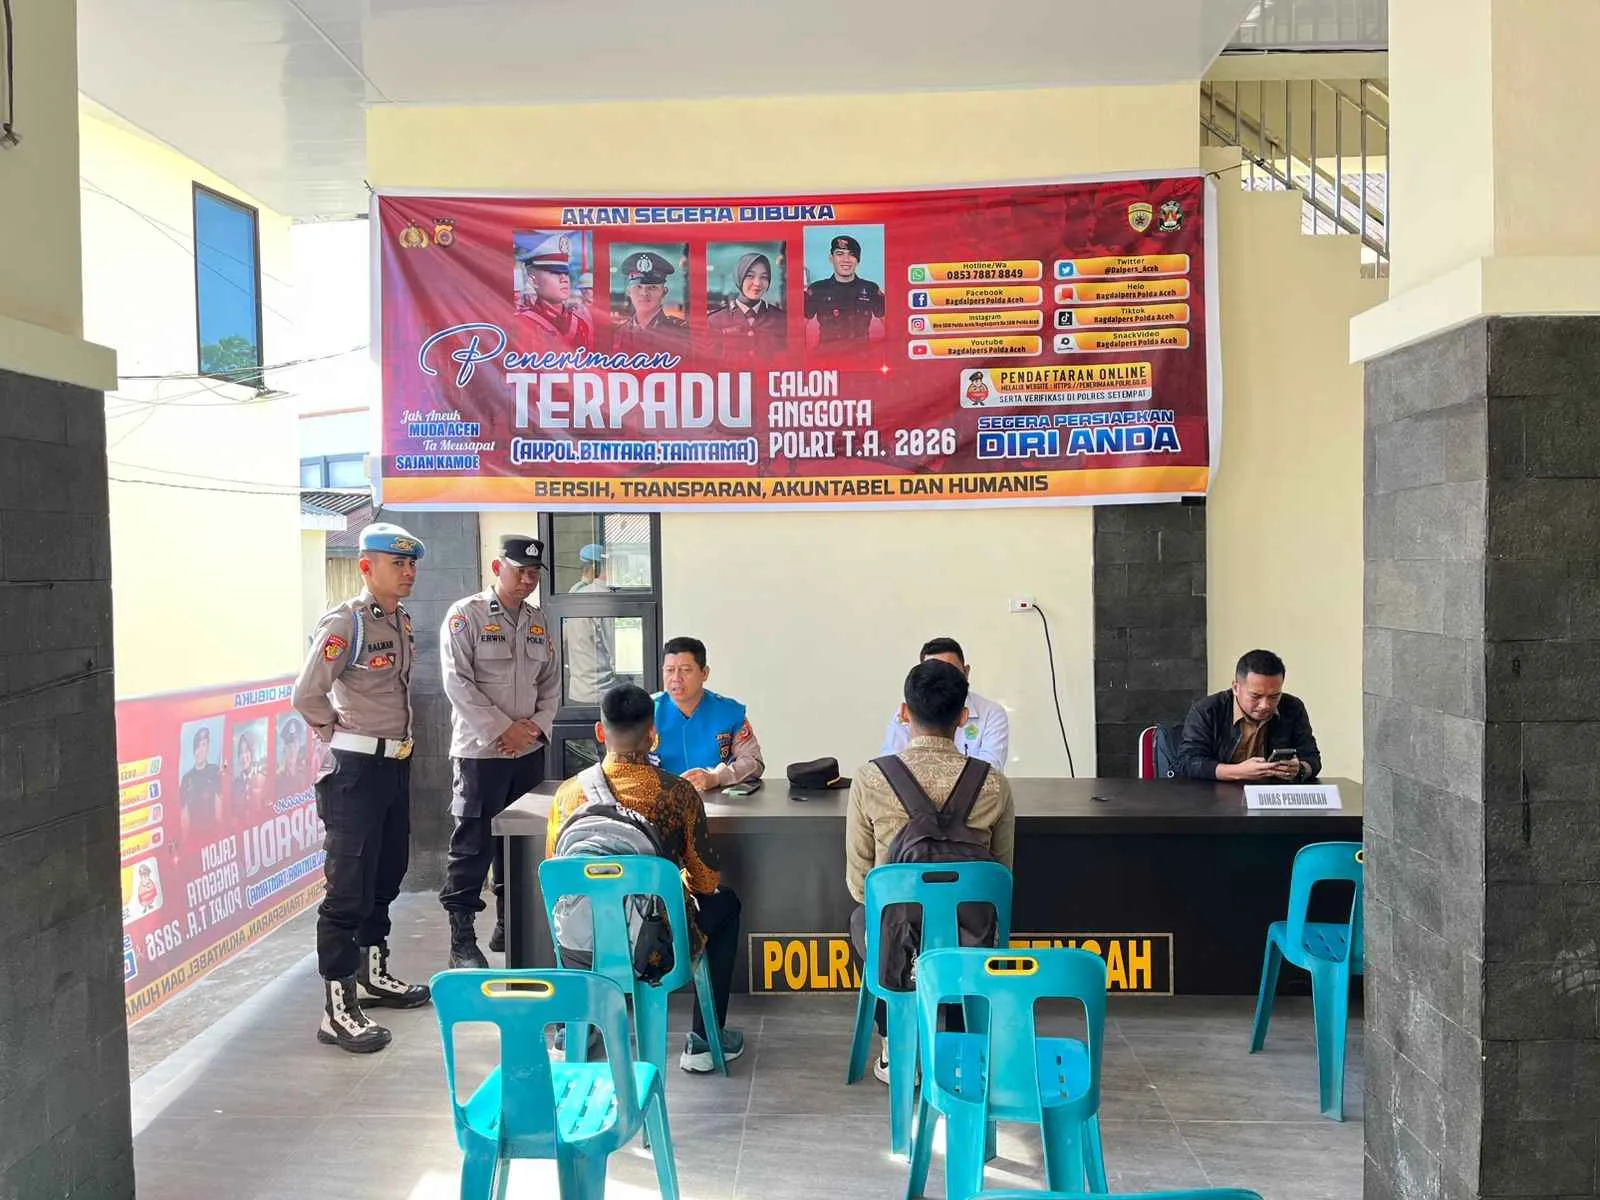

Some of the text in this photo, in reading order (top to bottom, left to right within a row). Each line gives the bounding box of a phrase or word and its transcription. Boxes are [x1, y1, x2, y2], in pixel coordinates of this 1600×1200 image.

[563, 205, 834, 225] AKAN SEGERA DIBUKA
[947, 269, 1023, 280] 0853 7887 8849
[1007, 296, 1024, 304] Aceh
[1159, 289, 1177, 297] Aceh
[1113, 331, 1160, 339] SnackVideo
[418, 322, 682, 388] Penerimaan
[1001, 366, 1146, 383] PENDAFTARAN ONLINE
[768, 370, 838, 397] CALON
[506, 372, 752, 429] TERPADU
[1000, 390, 1147, 403] SERTA VERIFIKASI DI POLRES SETEMPAT
[400, 410, 461, 424] Jak Aneuk
[768, 400, 872, 428] ANGGOTA
[978, 410, 1174, 429] SEGERA PERSIAPKAN
[408, 422, 480, 437] MUDA ACEH
[423, 440, 437, 450] Ta
[769, 428, 956, 458] POLRI T.A. 2026
[977, 425, 1181, 459] DIRI ANDA
[396, 455, 480, 470] SAJAN KAMOE
[535, 475, 1048, 499] BERSIH, TRANSPARAN, AKUNTABEL DAN HUMANIS
[1258, 792, 1328, 805] DINAS PENDIDIKAN
[763, 940, 861, 990] POLR
